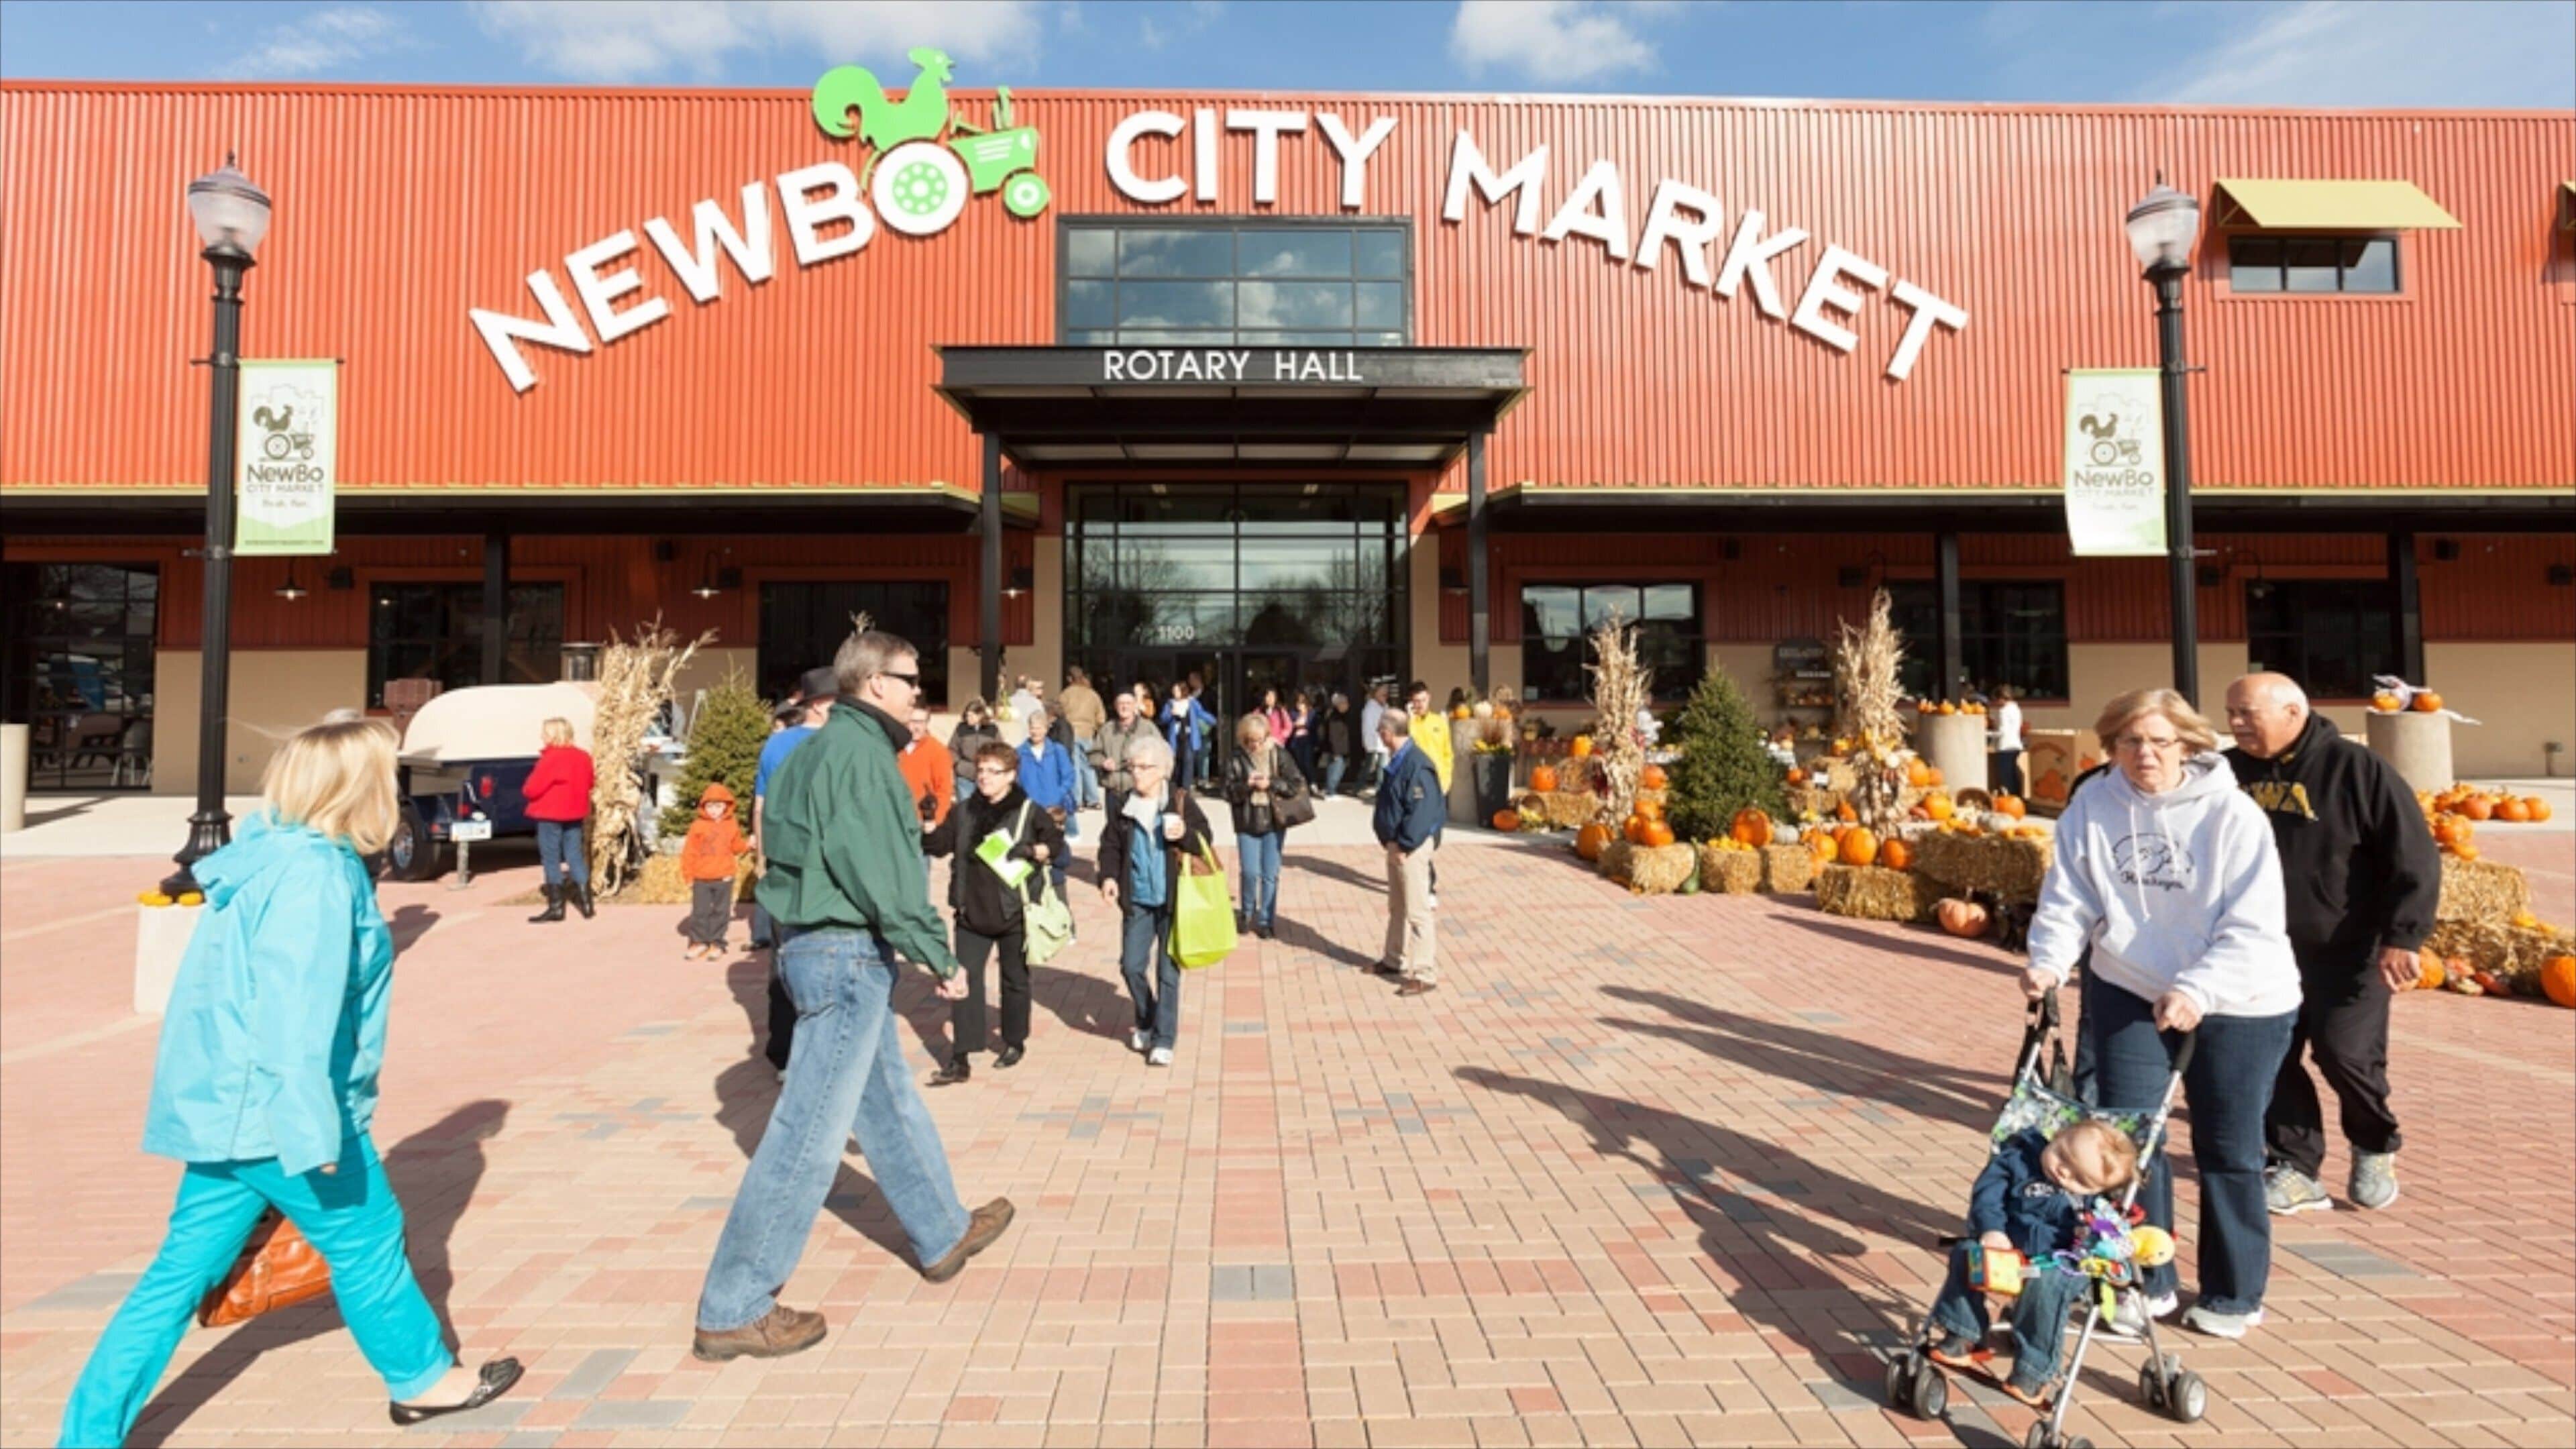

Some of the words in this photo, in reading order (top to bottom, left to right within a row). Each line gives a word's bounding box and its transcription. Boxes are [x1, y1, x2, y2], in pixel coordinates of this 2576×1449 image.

[1106, 107, 1399, 209] CITY
[1441, 127, 1970, 382] MARKET
[1104, 350, 1250, 381] ROTARY
[1274, 350, 1363, 382] HALL
[247, 463, 324, 482] NewBo
[2074, 468, 2155, 488] NewBo
[1157, 625, 1195, 640] 1100
